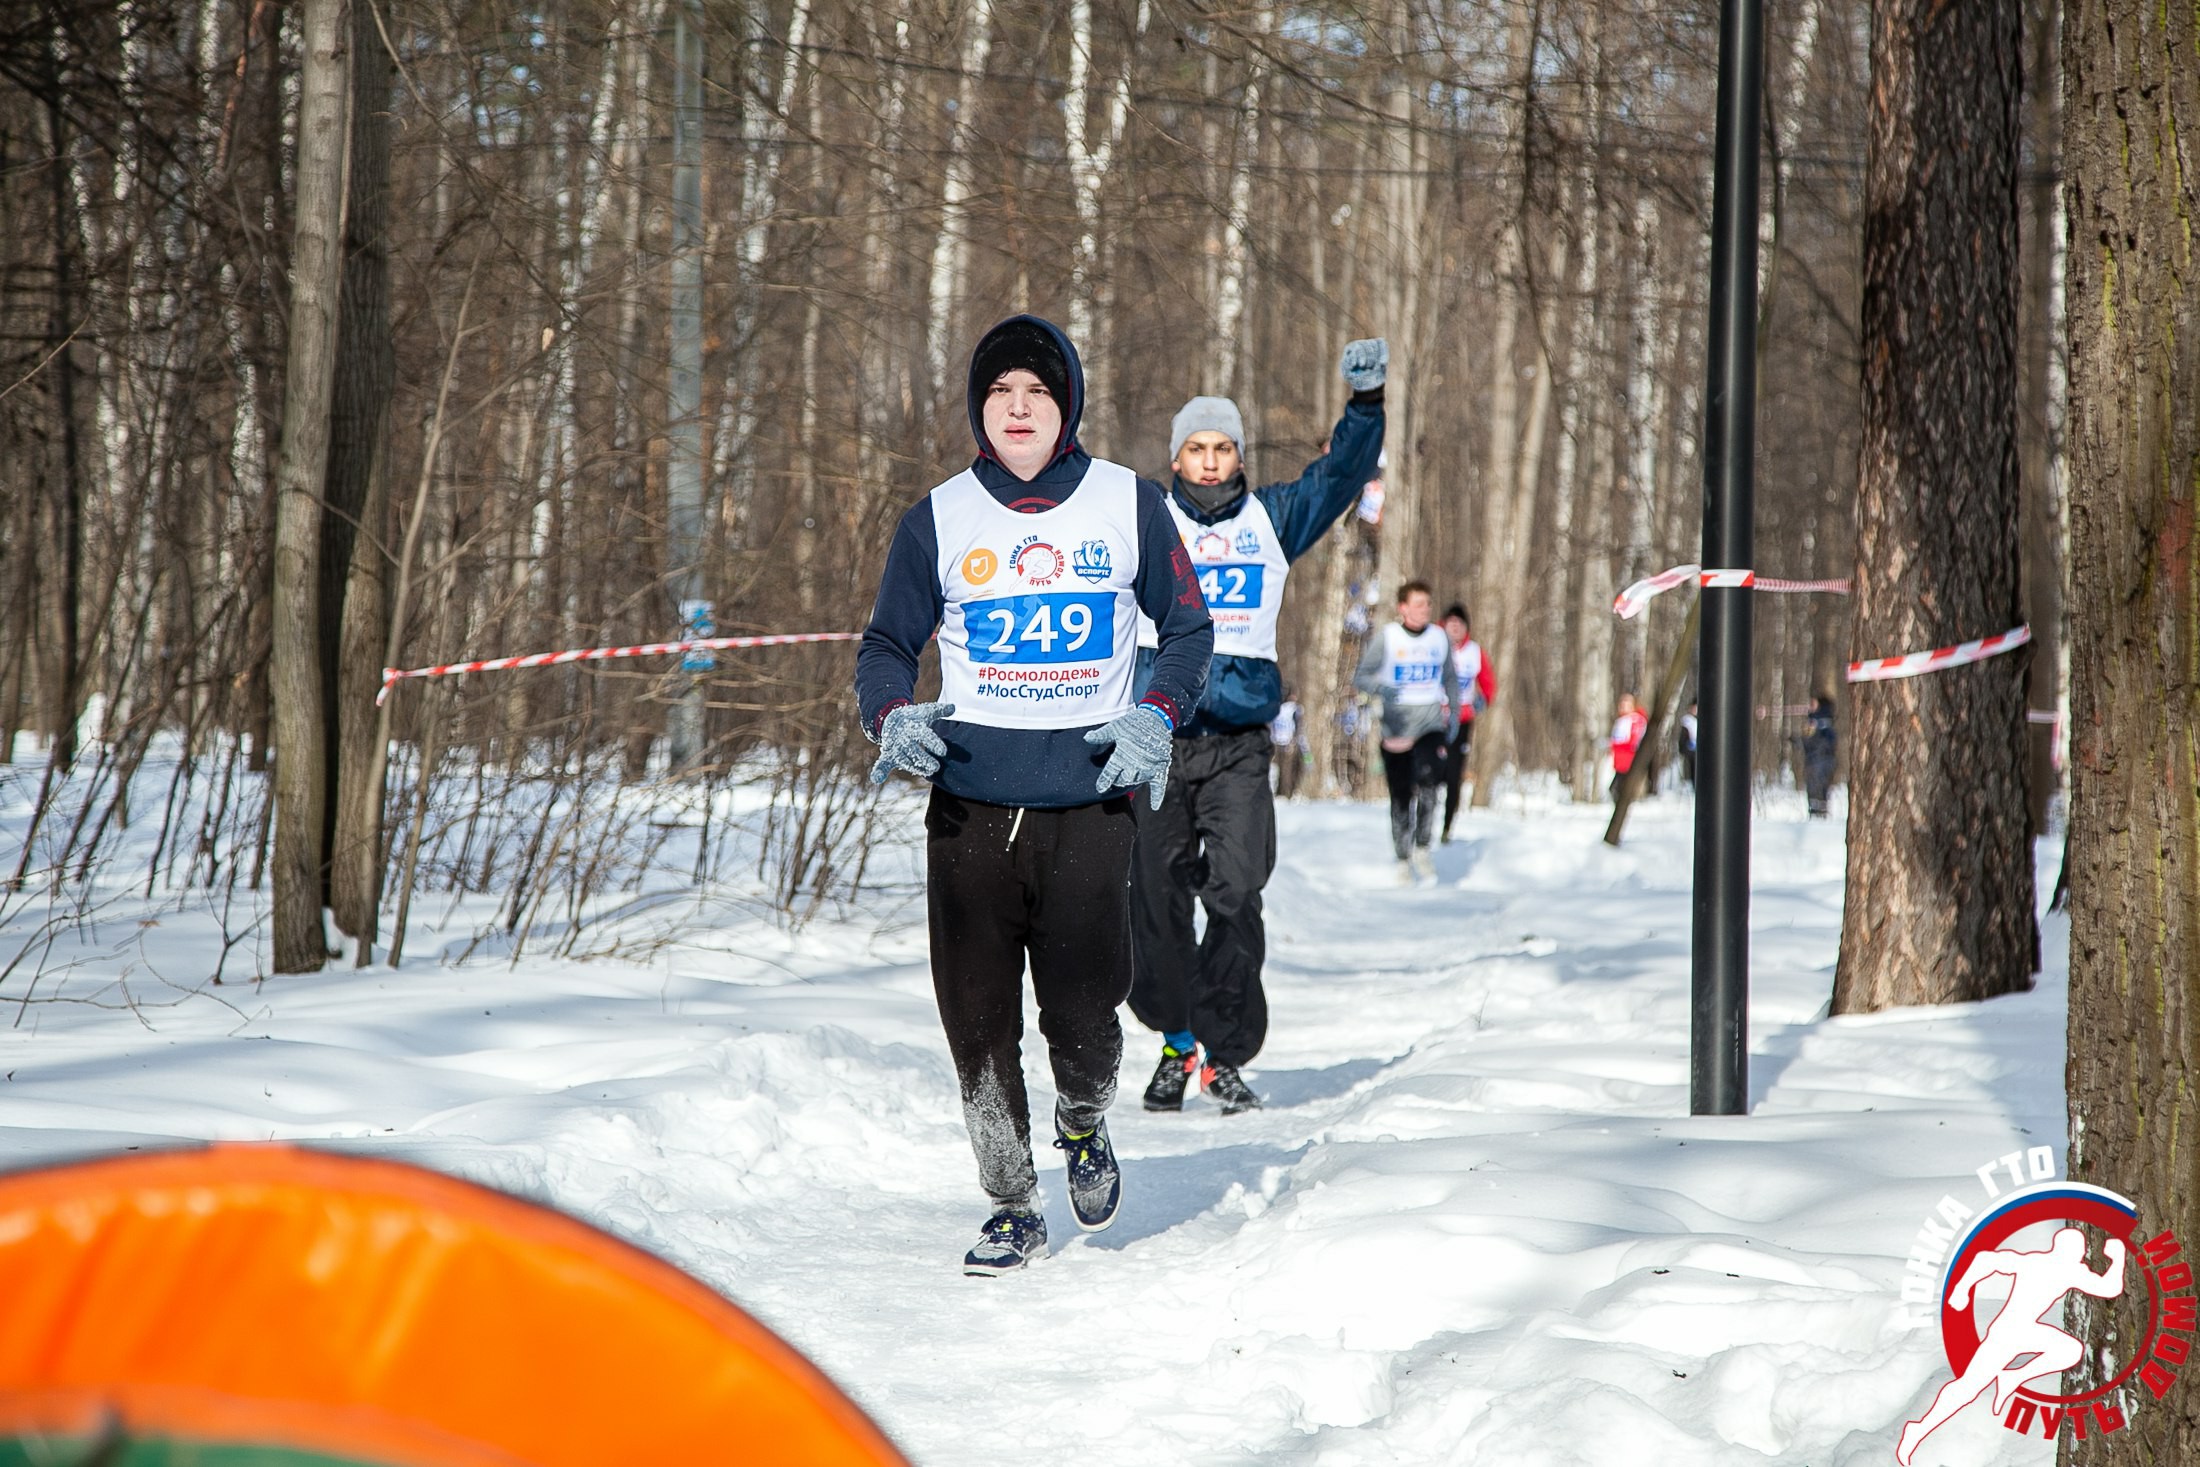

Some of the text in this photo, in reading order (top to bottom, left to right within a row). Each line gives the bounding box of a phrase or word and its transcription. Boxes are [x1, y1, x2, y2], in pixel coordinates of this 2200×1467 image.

[1009, 535, 1038, 569] ГОНКА ГТО
[1029, 579, 1052, 587] ПУТЬ
[1199, 567, 1247, 603] 42
[986, 602, 1093, 653] 249
[978, 666, 1100, 683] #Росмолодежь
[977, 683, 1100, 702] #МосСтудСпорт
